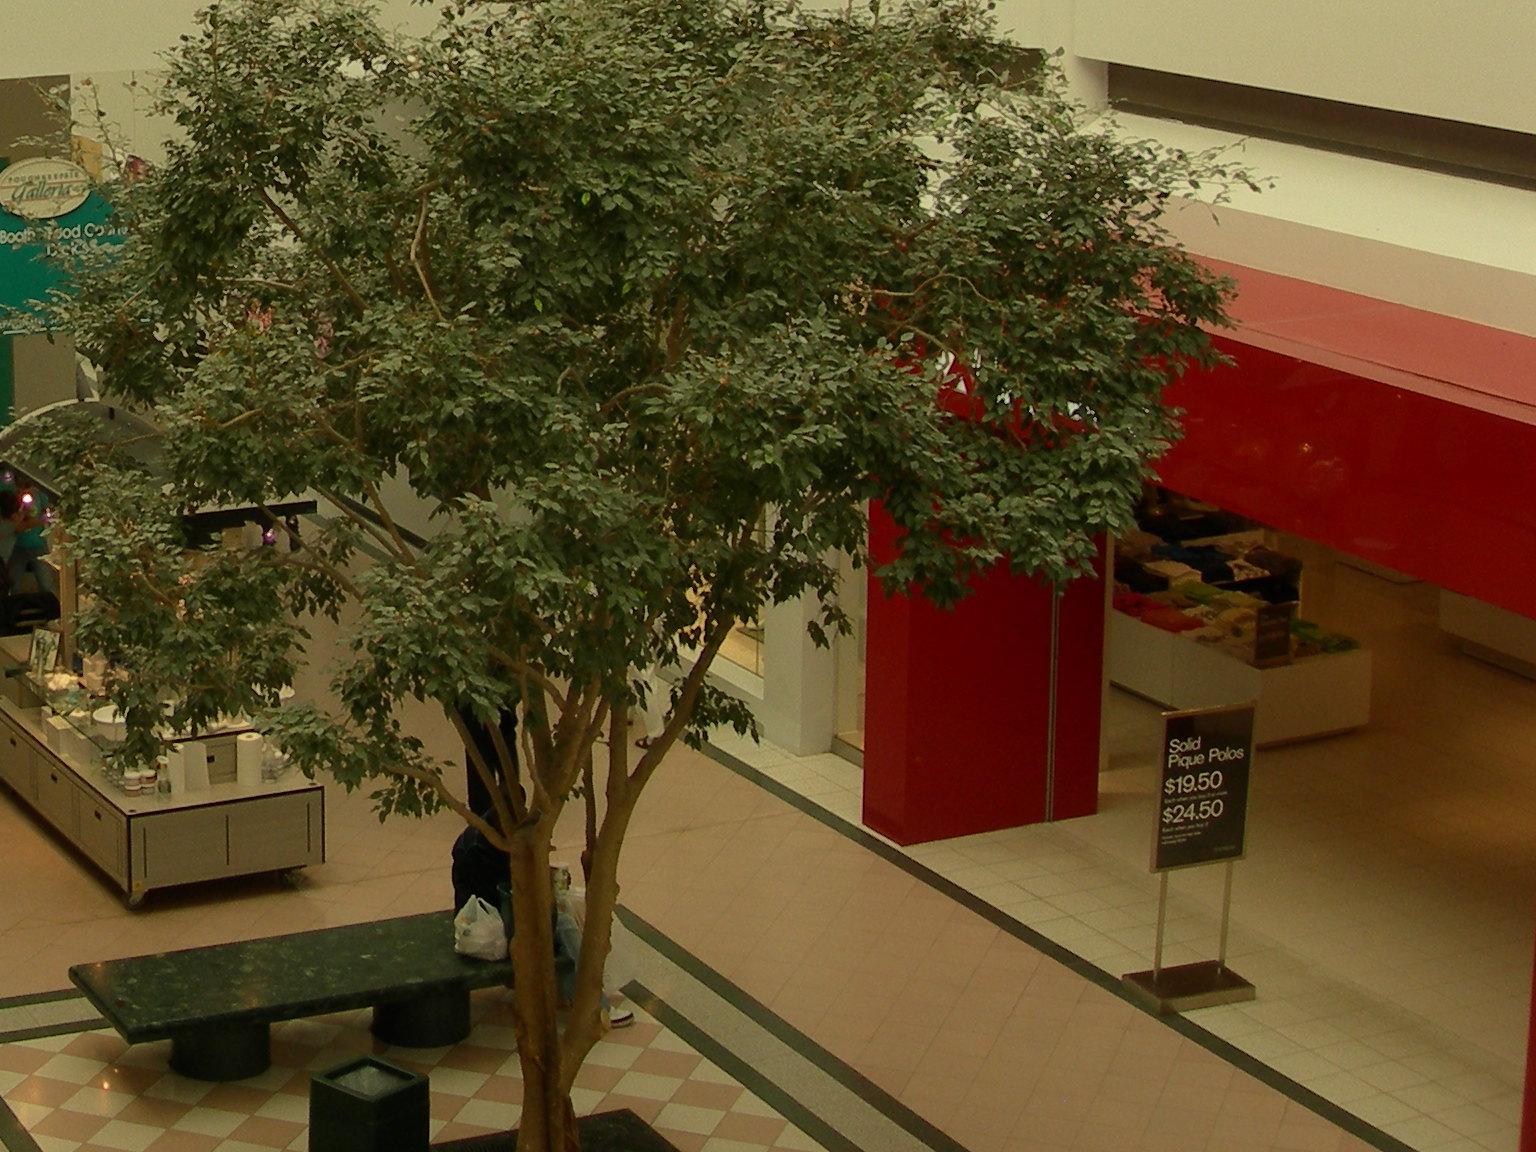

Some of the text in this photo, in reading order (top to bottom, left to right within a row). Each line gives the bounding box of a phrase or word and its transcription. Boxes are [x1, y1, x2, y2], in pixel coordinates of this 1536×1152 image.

[1168, 736, 1202, 754] Solid
[1167, 746, 1245, 770] Pique Polos
[1163, 770, 1223, 795] $19.50
[1161, 799, 1224, 824] $24.50
